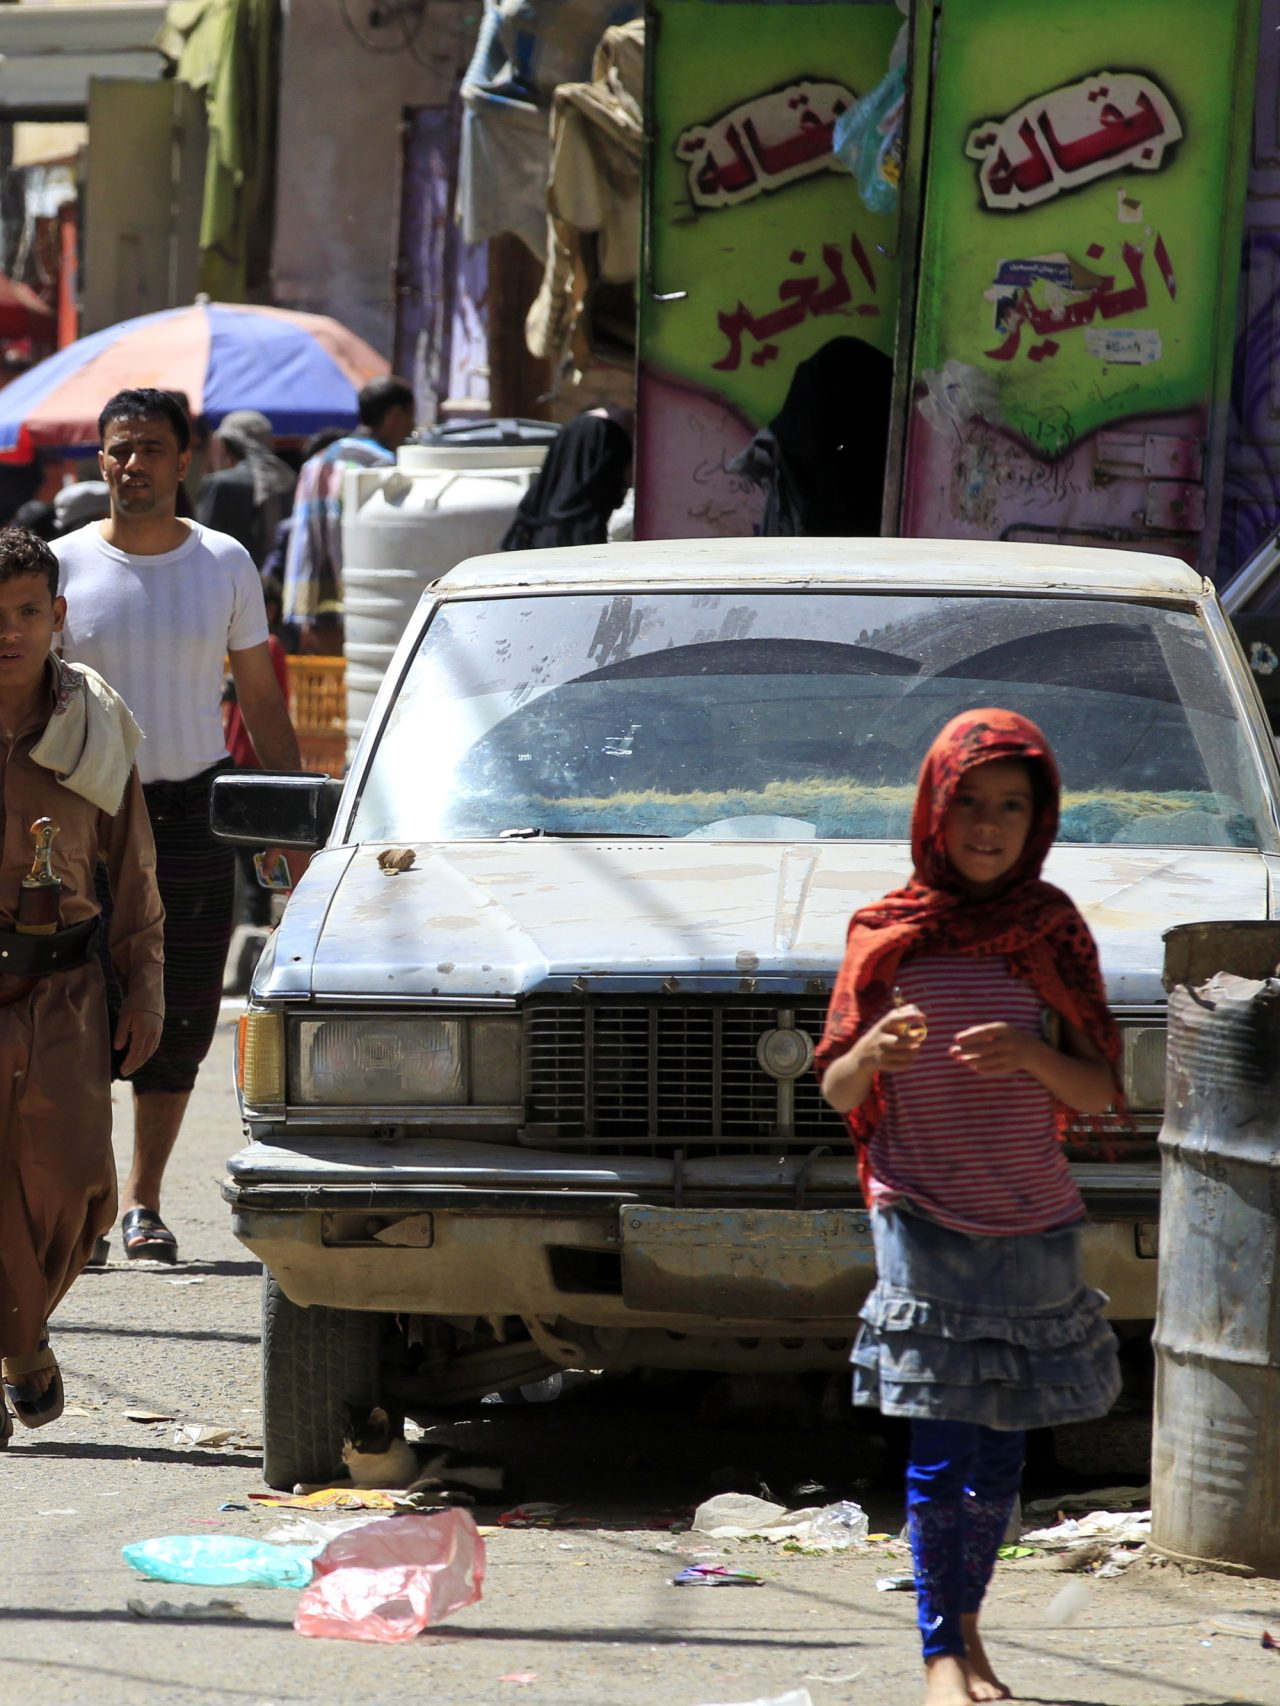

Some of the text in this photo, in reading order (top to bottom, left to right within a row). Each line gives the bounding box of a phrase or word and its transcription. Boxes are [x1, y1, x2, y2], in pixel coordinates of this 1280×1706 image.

[682, 93, 848, 195] قالة
[974, 85, 1165, 196] بقالة
[711, 231, 877, 371] الخير
[984, 233, 1176, 362] الخير
